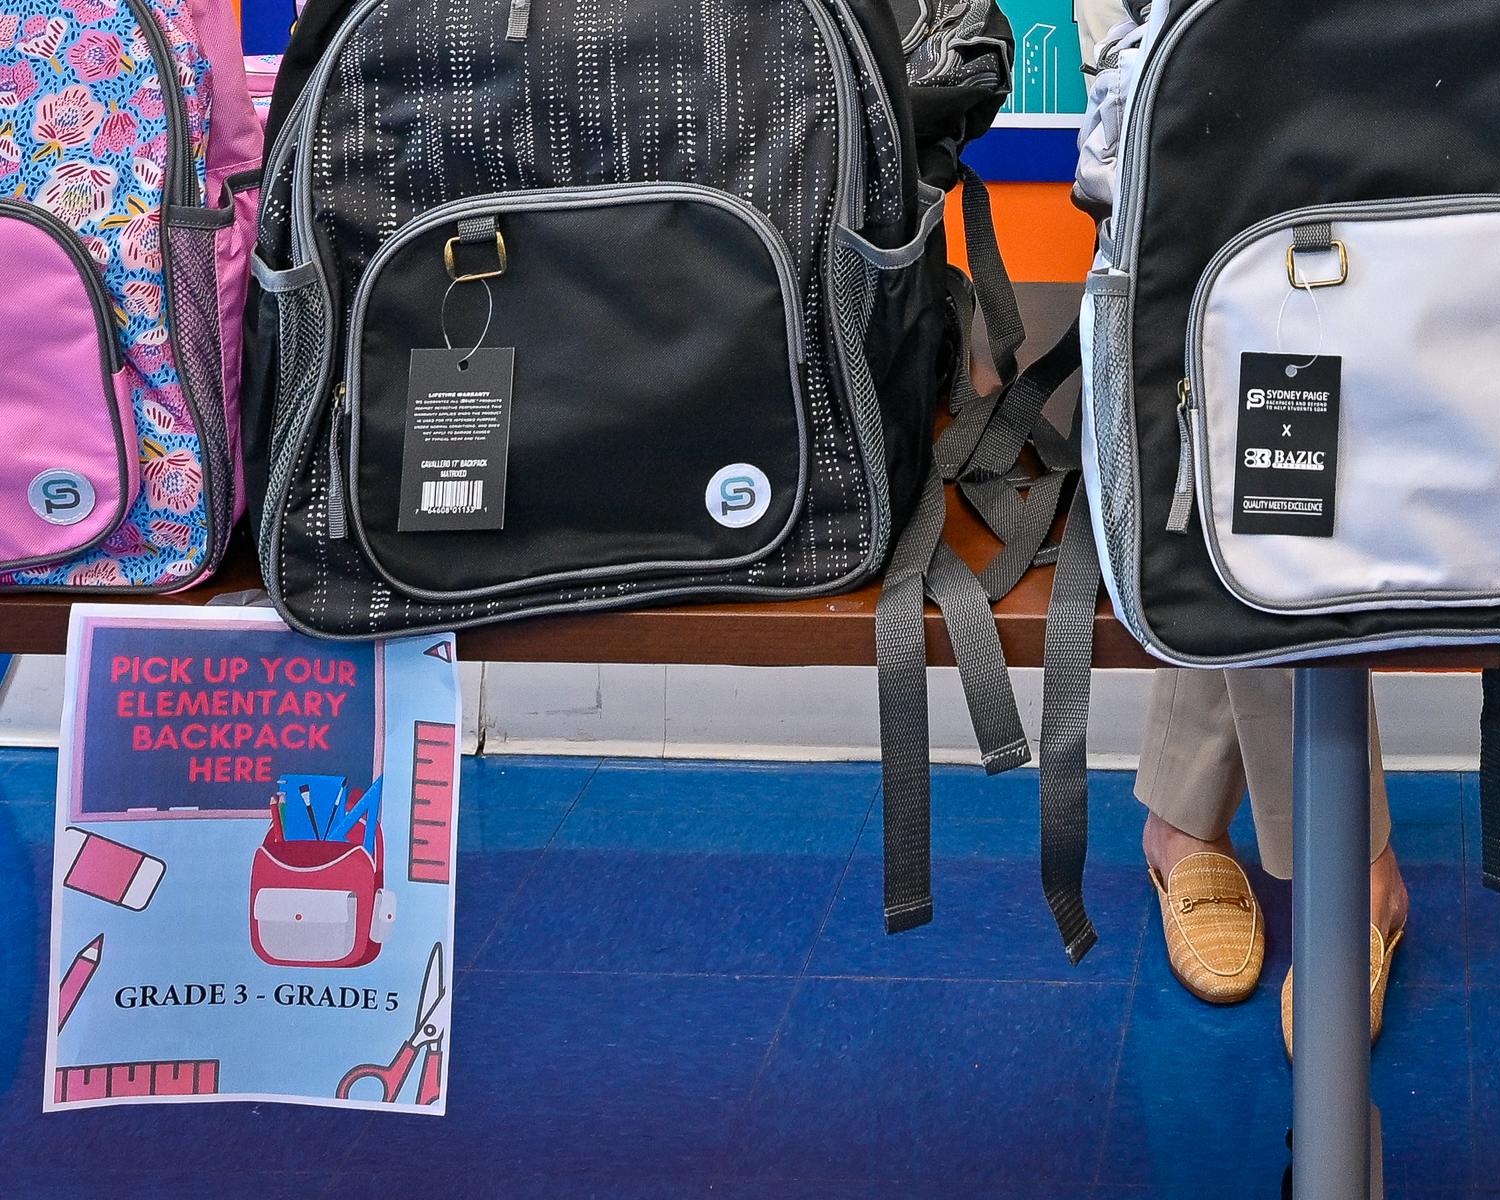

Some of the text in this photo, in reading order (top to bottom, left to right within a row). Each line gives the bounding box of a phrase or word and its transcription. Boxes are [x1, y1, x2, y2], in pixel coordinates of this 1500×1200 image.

[1266, 389, 1330, 401] SYDNEY PAIGE
[1274, 449, 1326, 466] BAZIC
[1243, 499, 1323, 512] QUALITY MEETS EXCELLENCE
[110, 656, 357, 688] PICK UP YOUR
[117, 690, 348, 719] ELEMENTARY
[131, 723, 331, 752] BACKPACK
[187, 755, 274, 784] HERE
[114, 982, 226, 1010] GRADE
[232, 983, 249, 1006] 3
[273, 983, 379, 1011] GRADE
[384, 990, 400, 1012] 5
